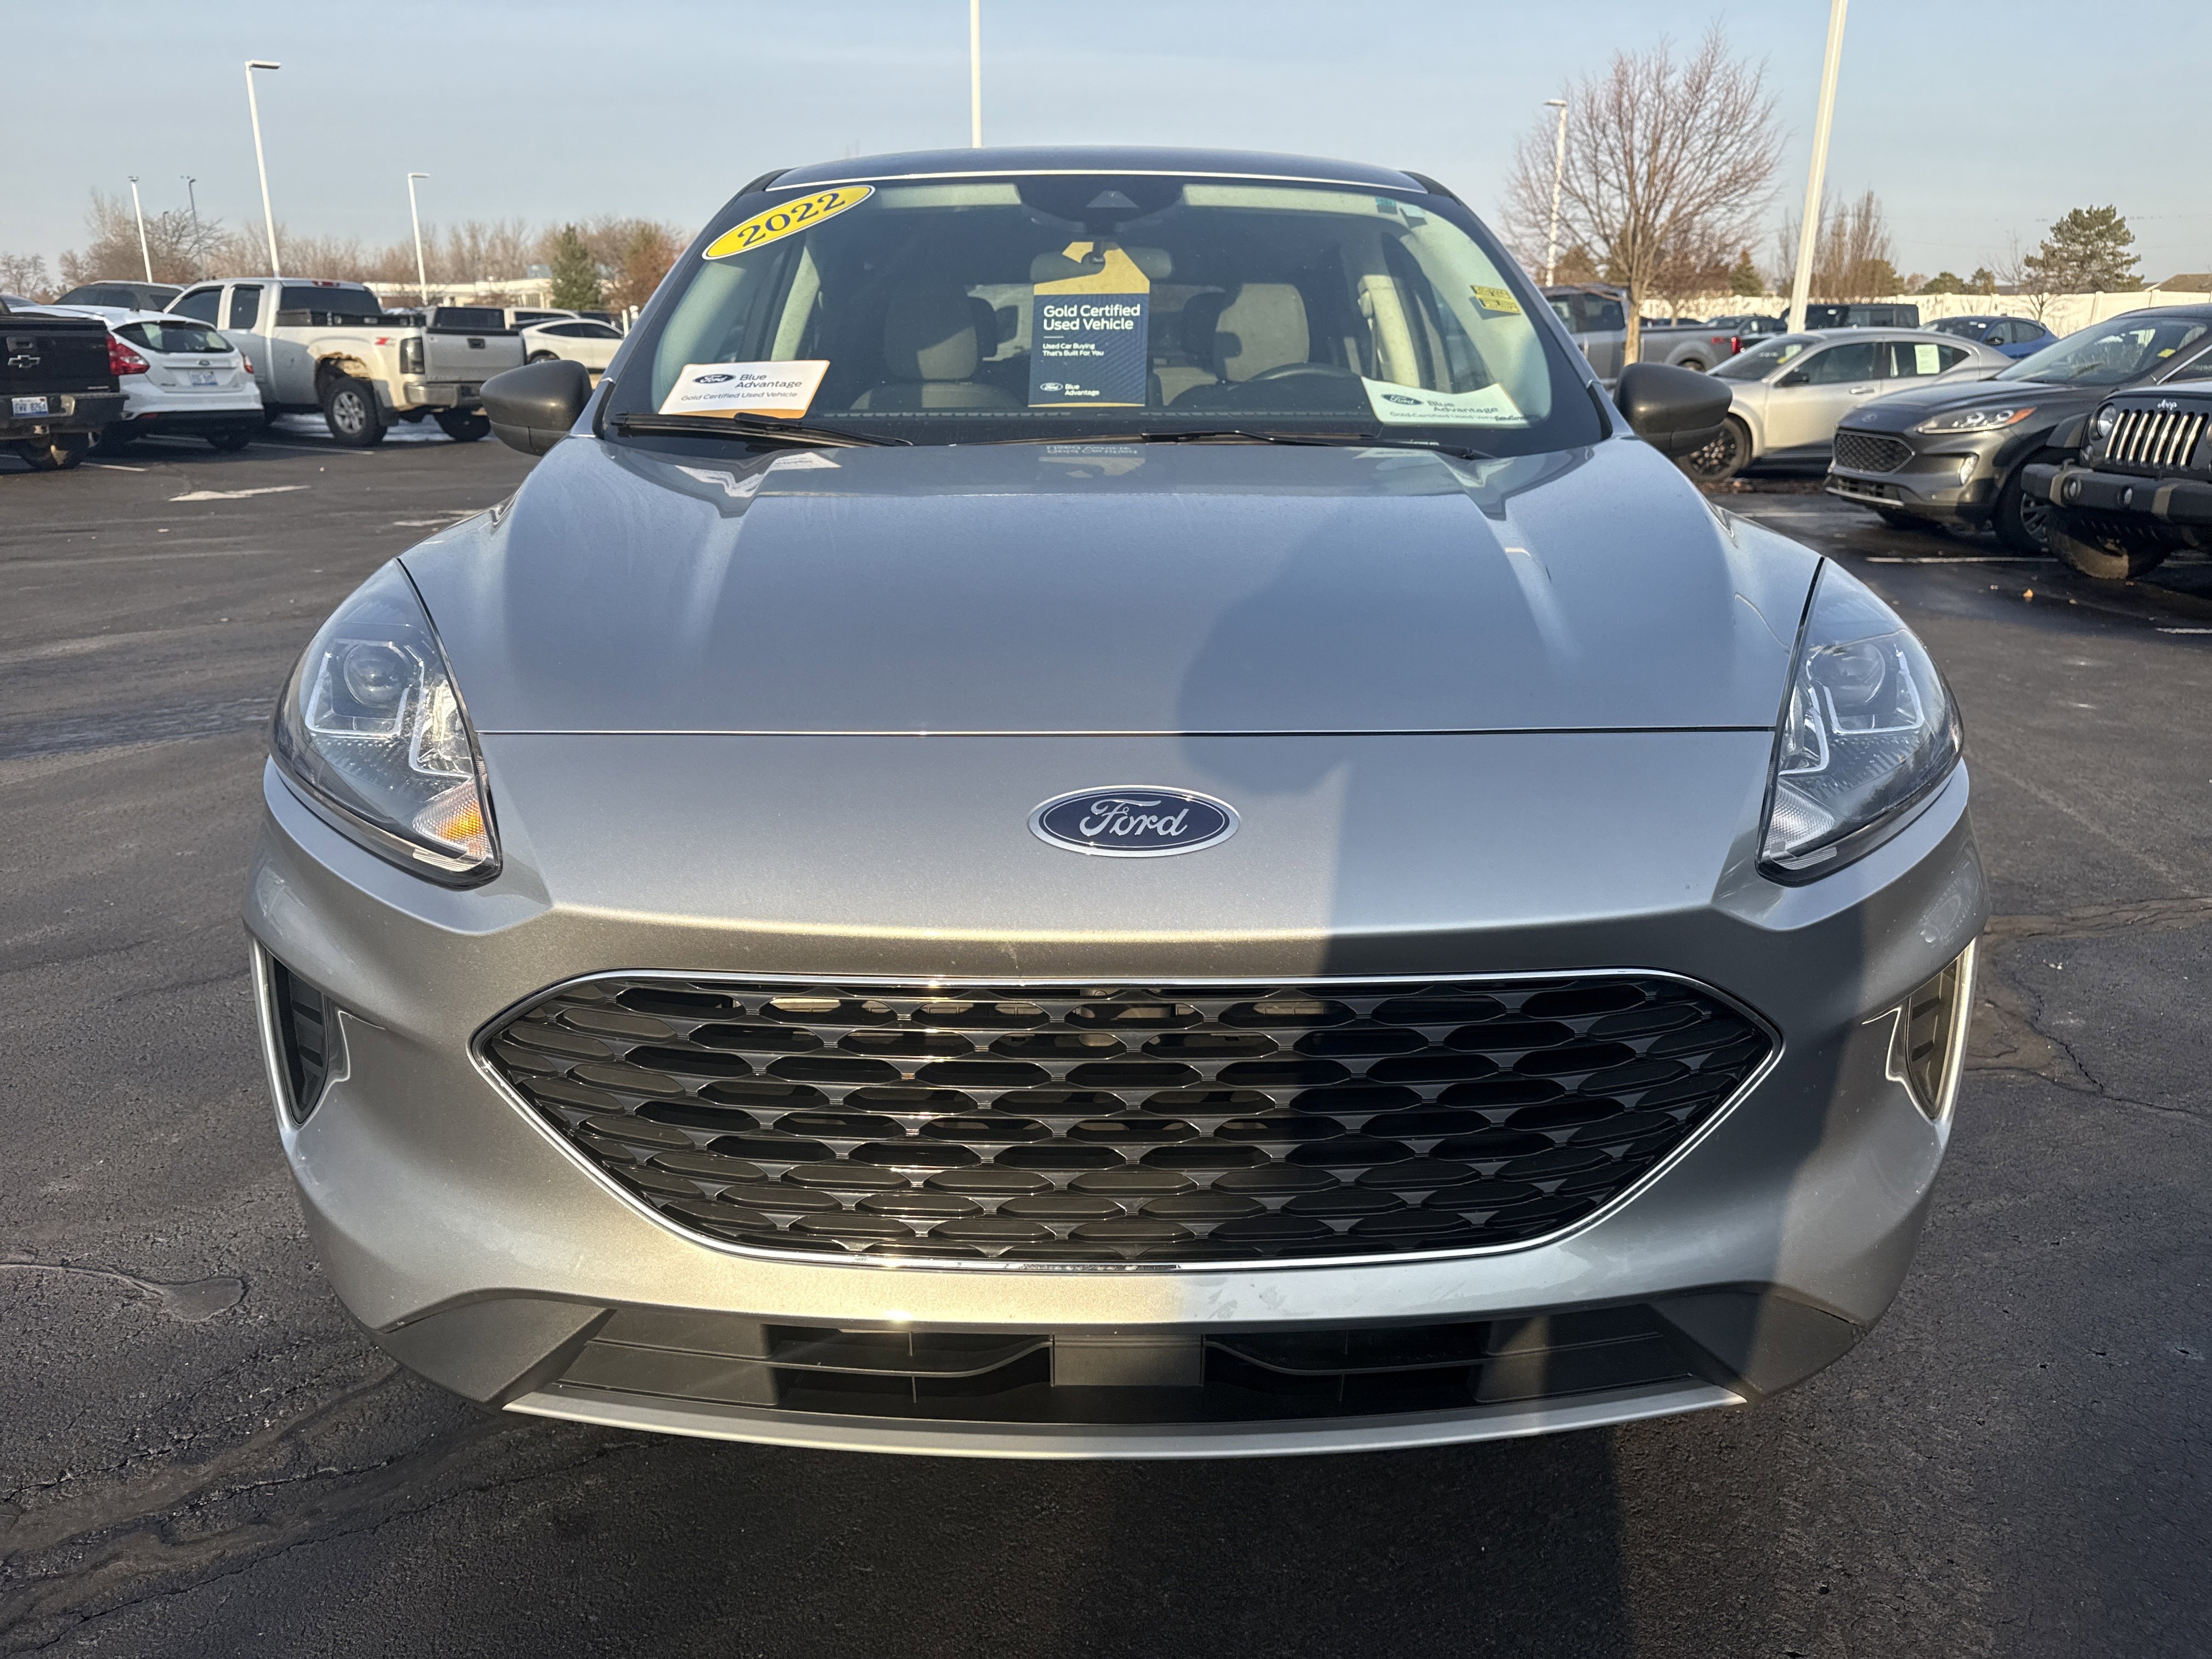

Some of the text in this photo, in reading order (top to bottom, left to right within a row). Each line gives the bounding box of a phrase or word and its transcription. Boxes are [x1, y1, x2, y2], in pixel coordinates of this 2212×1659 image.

[737, 193, 845, 247] 2022
[1043, 303, 1141, 317] Gold Certified
[1043, 317, 1134, 331] Used Vehicle
[699, 375, 728, 383] Ford
[1390, 394, 1414, 404] Ford
[1079, 798, 1189, 837] Ford
